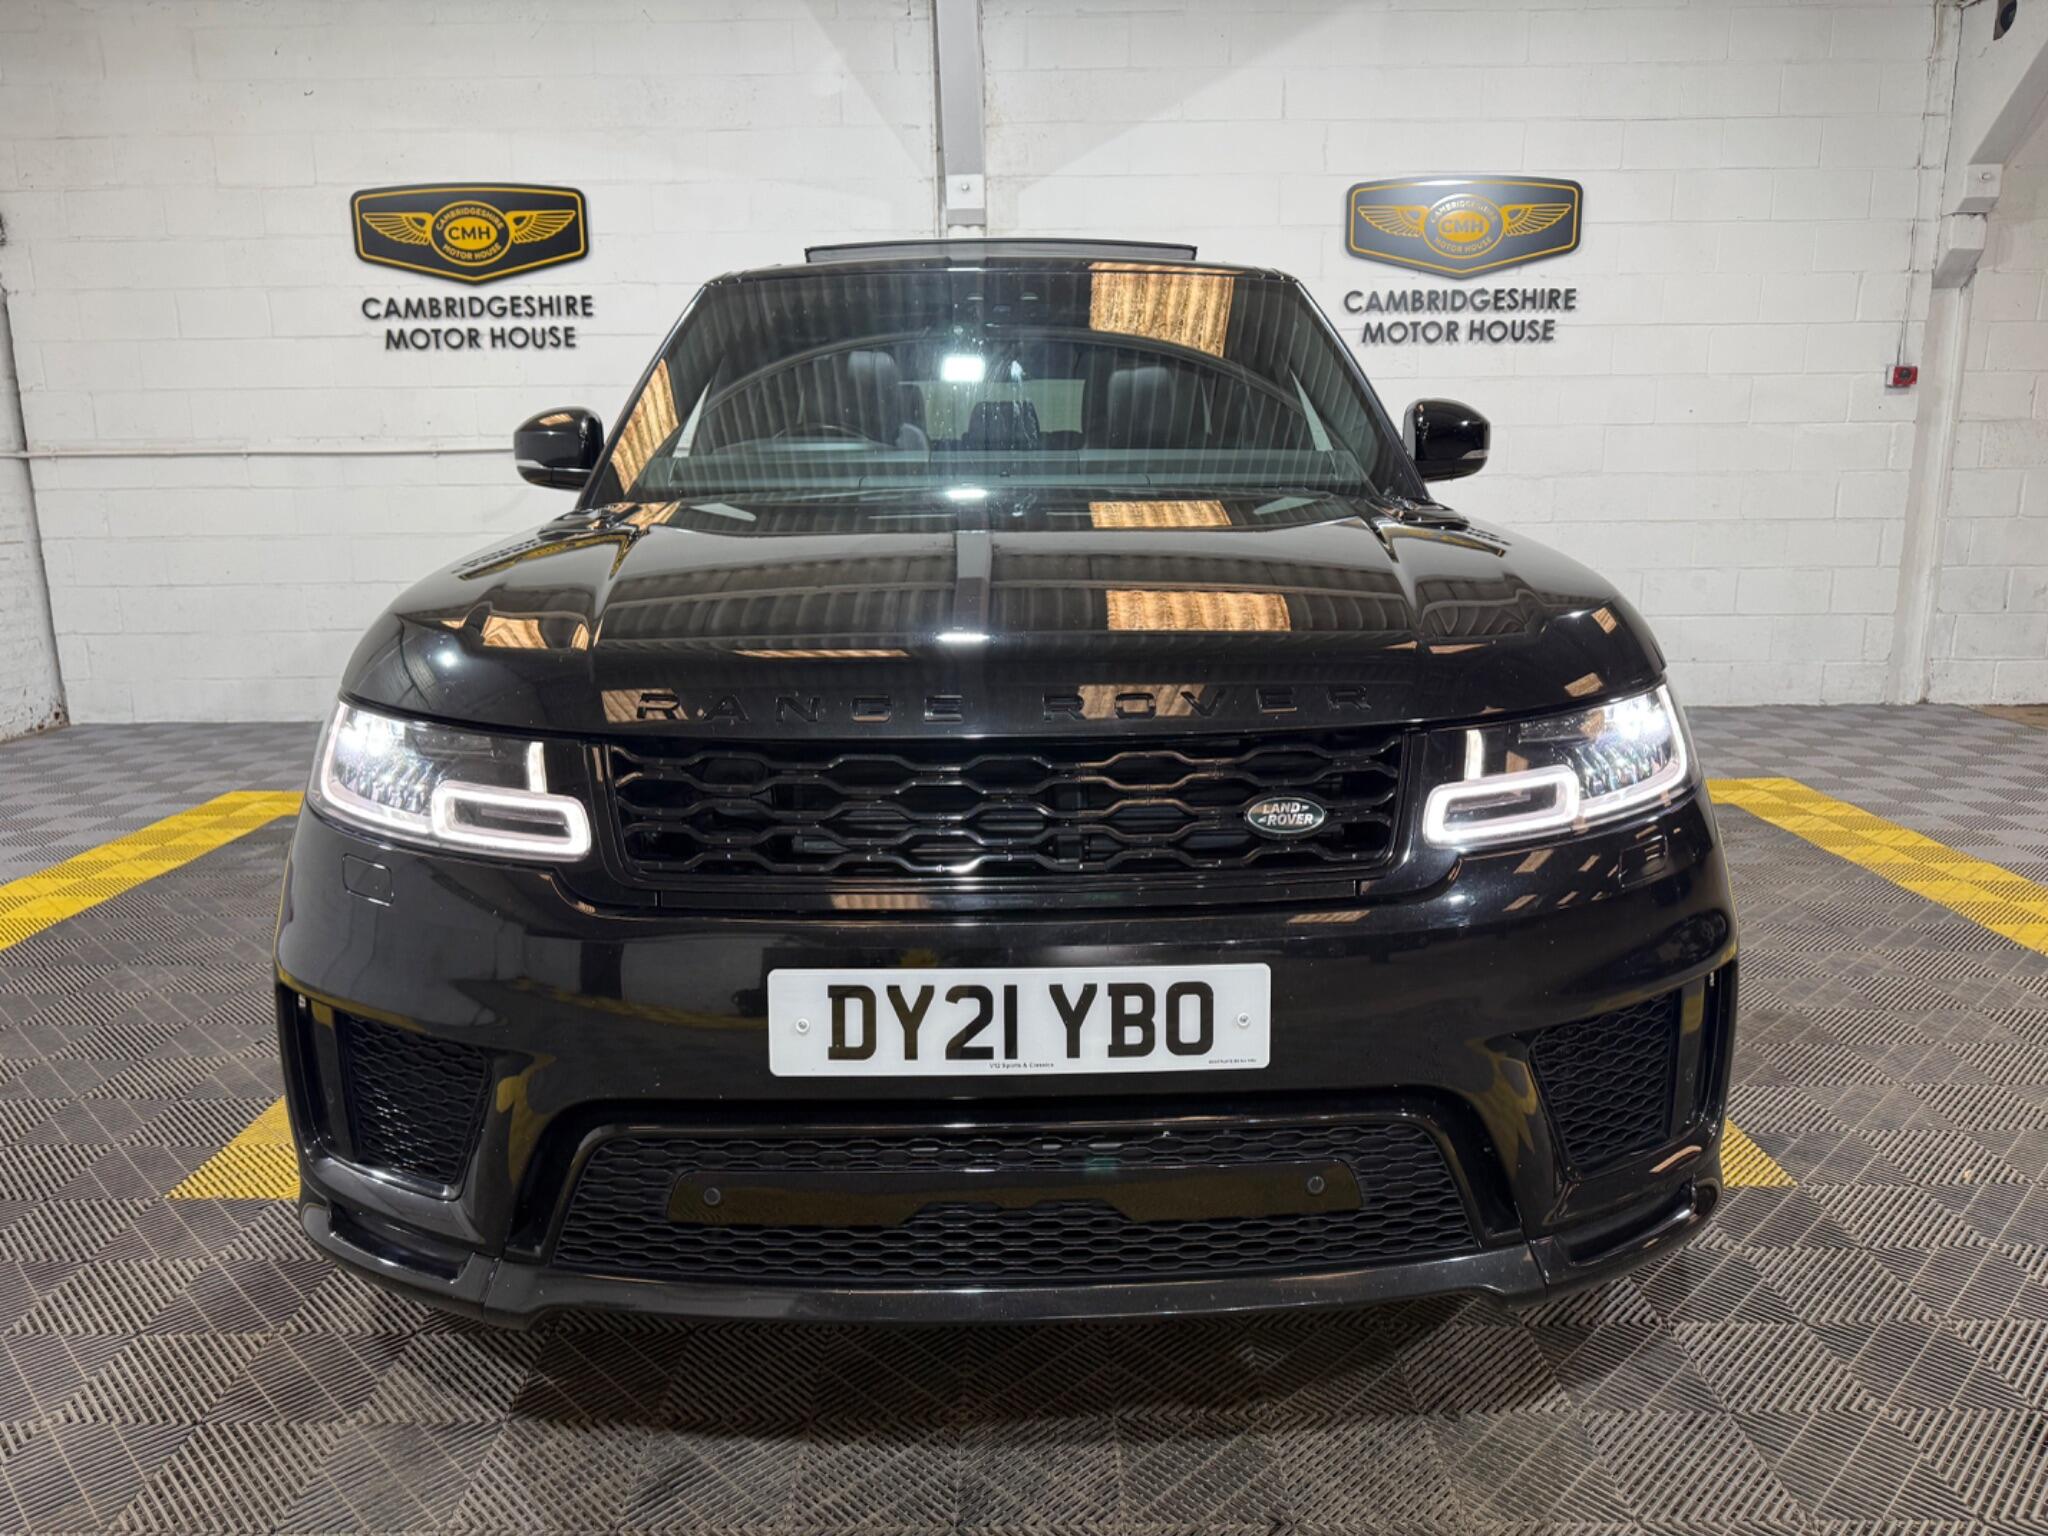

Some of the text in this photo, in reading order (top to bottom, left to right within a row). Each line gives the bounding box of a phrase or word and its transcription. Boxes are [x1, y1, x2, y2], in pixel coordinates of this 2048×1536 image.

[436, 207, 505, 230] CAMBRIDGESHIRE
[1441, 219, 1483, 233] CMH
[448, 226, 490, 240] CMH
[443, 242, 502, 259] MOTOR HOUSE
[362, 295, 594, 320] CAMBRIDGESHIRE
[1343, 288, 1577, 313] CAMBRIDGESHIRE
[385, 327, 577, 350] MOTOR HOUSE
[1362, 319, 1556, 344] MOTOR HOUSE
[636, 686, 1371, 723] RANGE ROVER
[1262, 802, 1300, 814] LAND
[1266, 813, 1314, 826] ROVER
[827, 981, 1214, 1061] DY21 YBO
